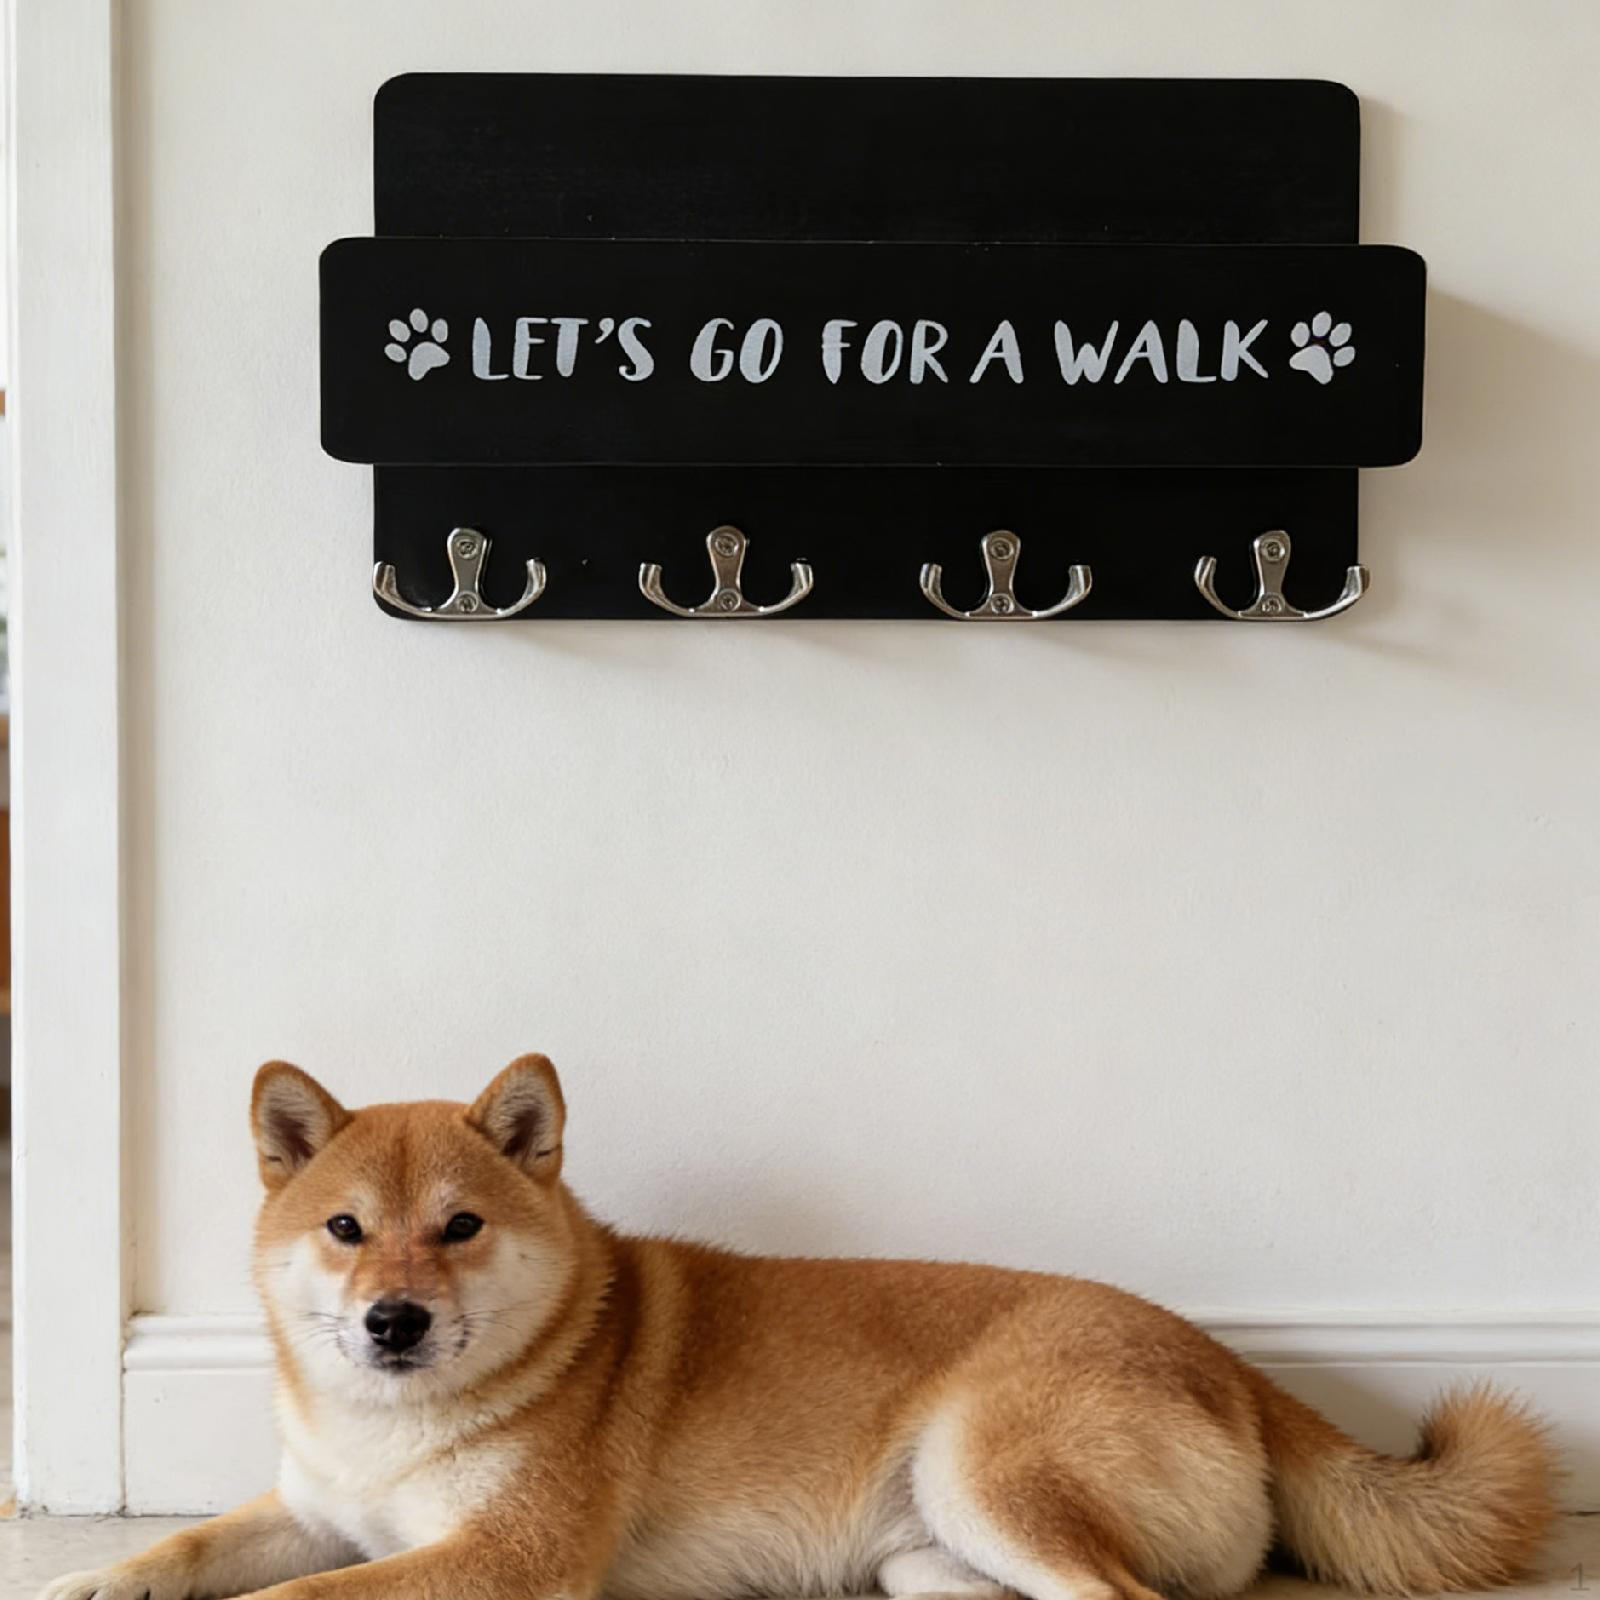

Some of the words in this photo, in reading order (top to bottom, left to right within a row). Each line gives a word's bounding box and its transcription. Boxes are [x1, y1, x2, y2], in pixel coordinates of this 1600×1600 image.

[472, 317, 655, 382] LET'S
[690, 317, 783, 383] GO
[821, 319, 948, 384] FOR
[969, 319, 1024, 384] A
[1054, 319, 1269, 386] WALK
